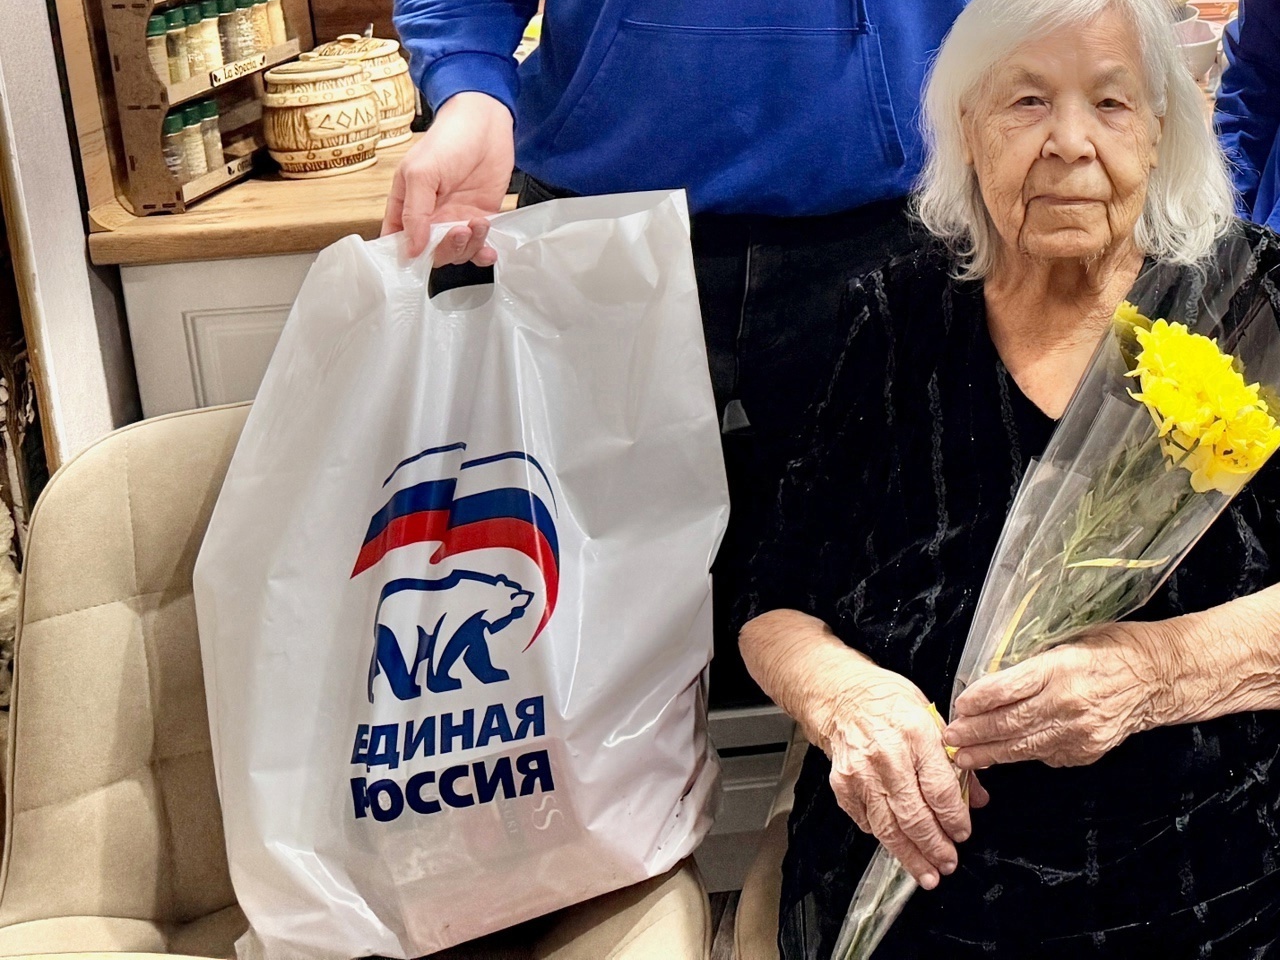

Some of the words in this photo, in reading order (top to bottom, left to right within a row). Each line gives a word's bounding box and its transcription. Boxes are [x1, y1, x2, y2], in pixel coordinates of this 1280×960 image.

[318, 107, 374, 131] СОЛЬ
[351, 695, 545, 773] ЕДИНАЯ
[350, 749, 555, 822] РОССИЯ
